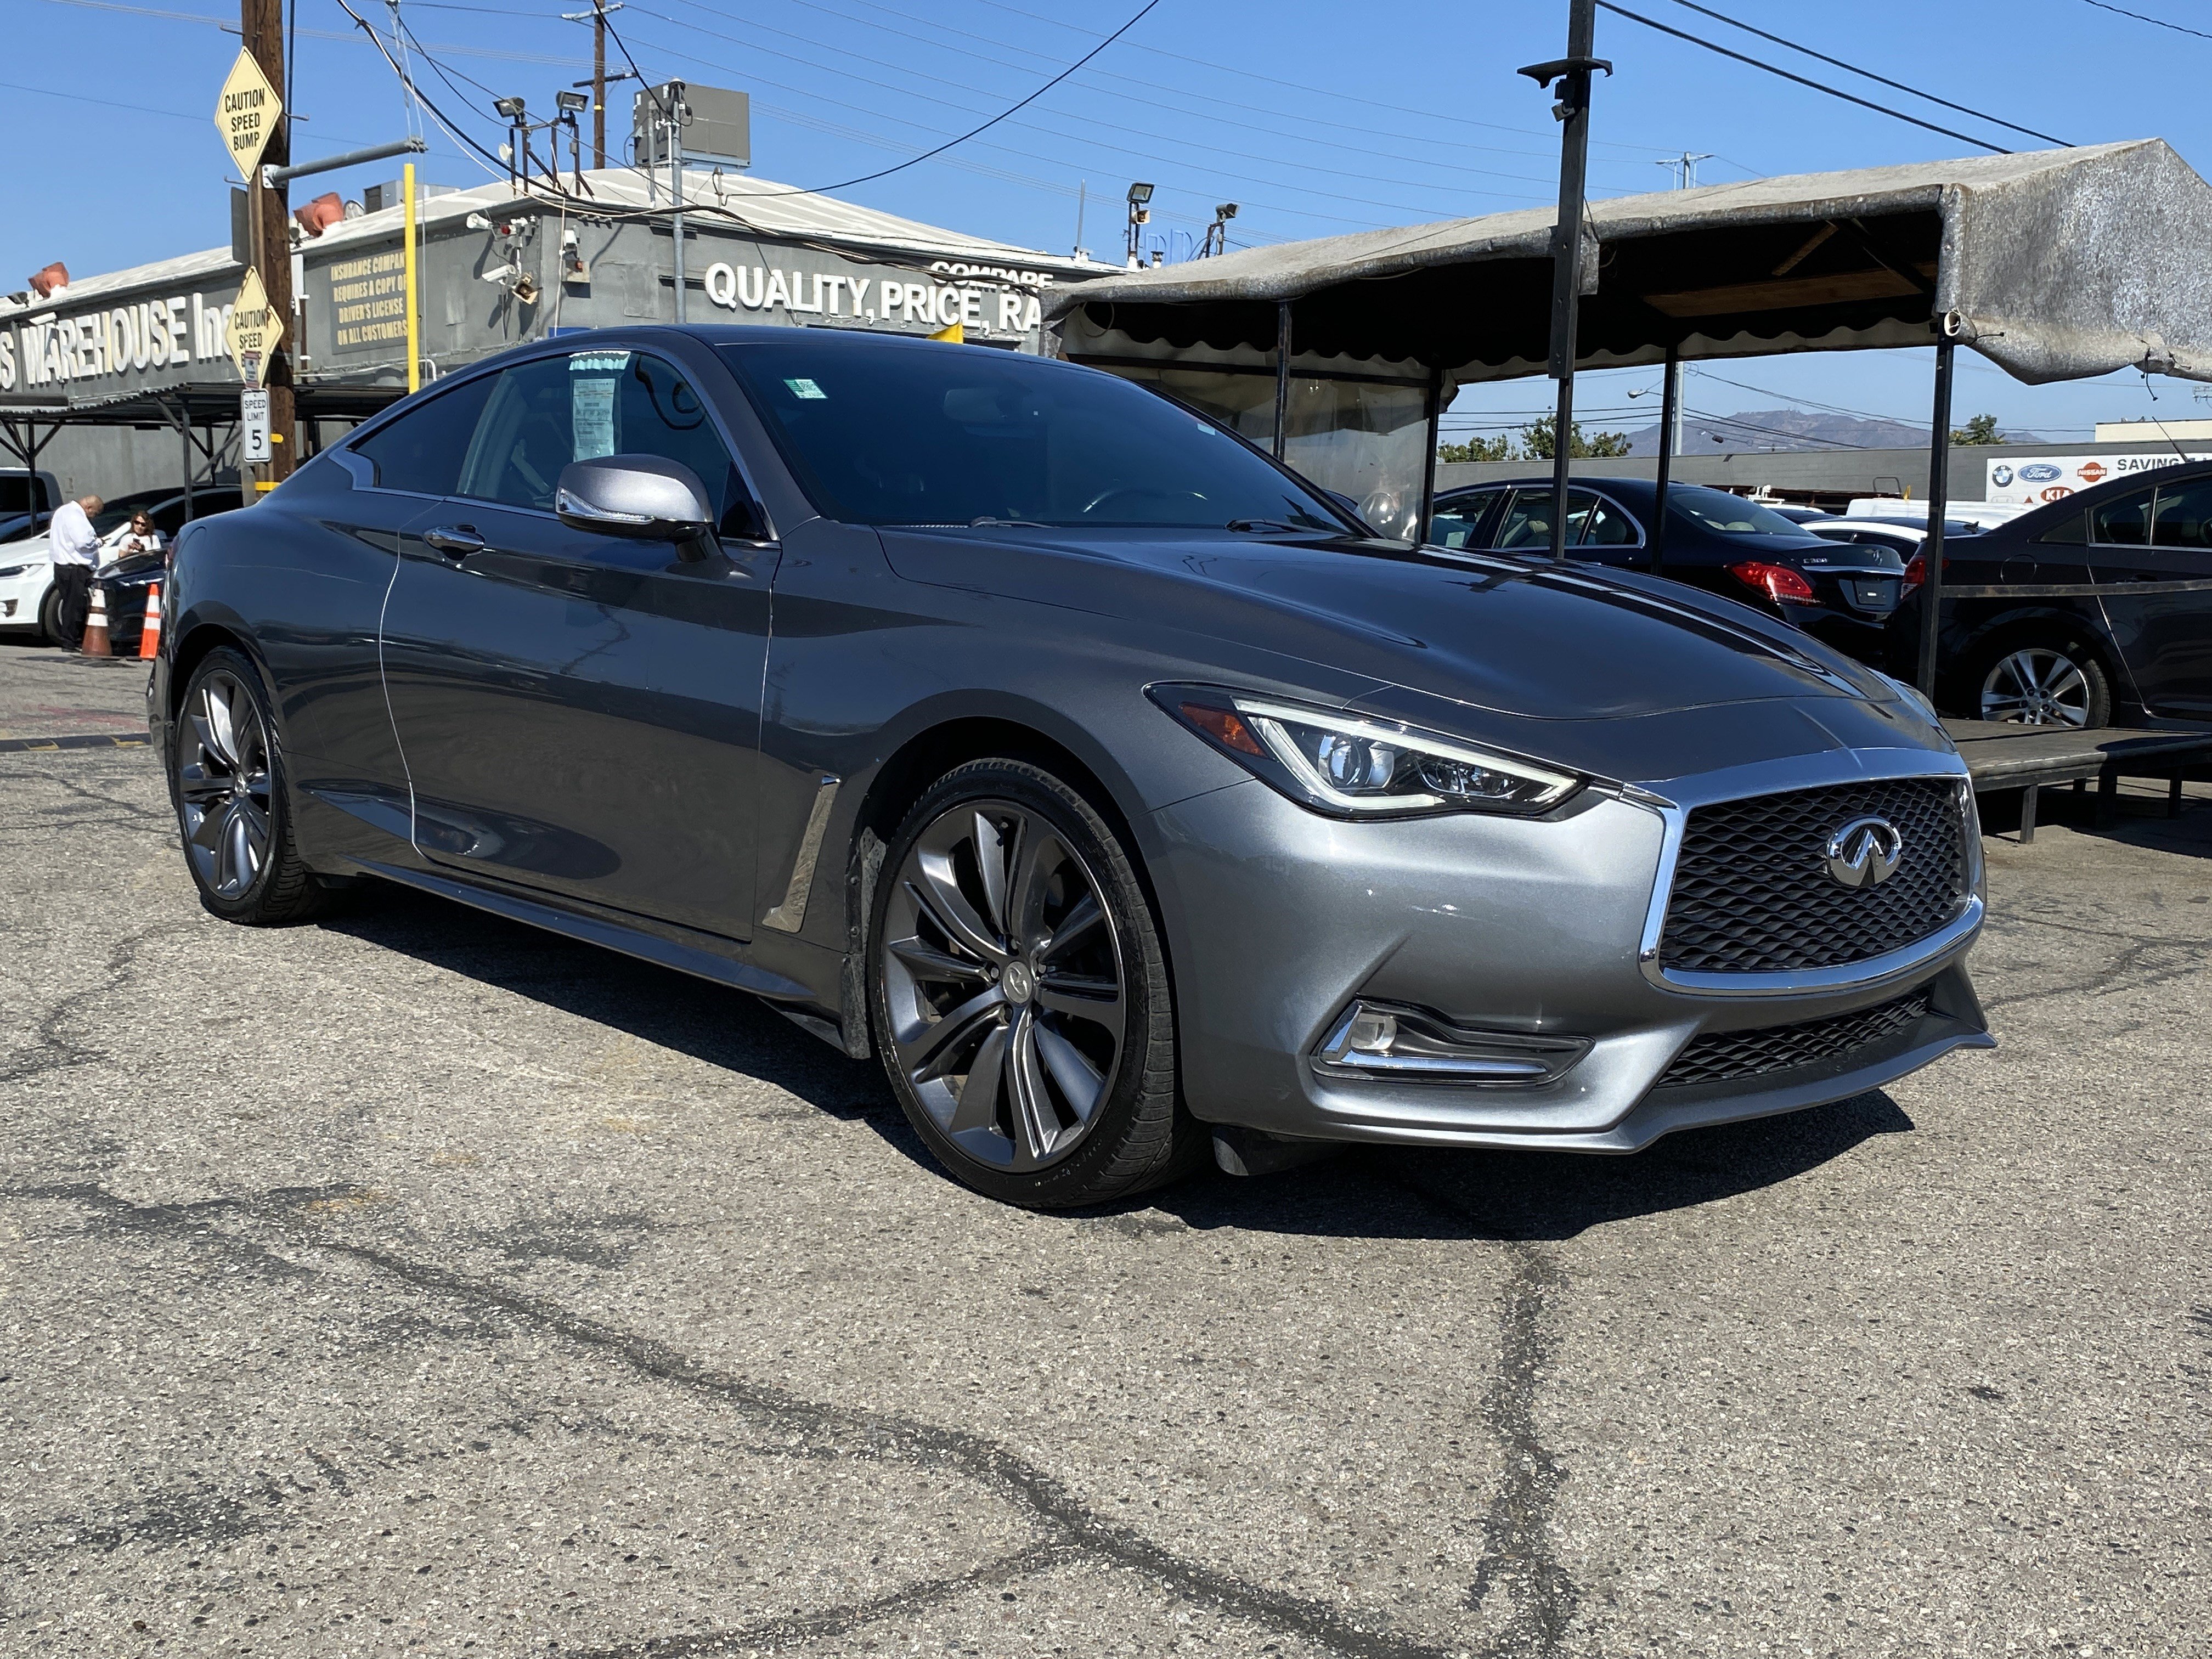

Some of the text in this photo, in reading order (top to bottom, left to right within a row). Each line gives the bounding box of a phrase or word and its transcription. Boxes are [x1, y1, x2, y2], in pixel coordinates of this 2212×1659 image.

[225, 88, 264, 113] CAUTION
[231, 112, 260, 133] SPEED
[233, 132, 259, 151] BUMP
[331, 252, 405, 281] INSURANCE COMPAN
[930, 261, 1054, 294] COMPARE
[334, 281, 368, 302] REQUIRES
[369, 280, 375, 296] A
[375, 275, 396, 295] COPY
[705, 262, 876, 326] QUALITY,
[881, 280, 990, 336] PRICE,
[235, 308, 267, 330] CAUTION
[338, 297, 404, 324] DRIVER'S LICENSE
[21, 296, 190, 385] WAREHOUSE
[239, 332, 262, 349] SPEED
[337, 319, 408, 346] ON ALL CUSTOMERS
[241, 351, 262, 368] BP
[245, 399, 266, 409] SPEED
[247, 411, 264, 421] LIMIT
[252, 429, 262, 450] 5
[2027, 468, 2052, 478] Ford
[2046, 489, 2070, 500] KIA
